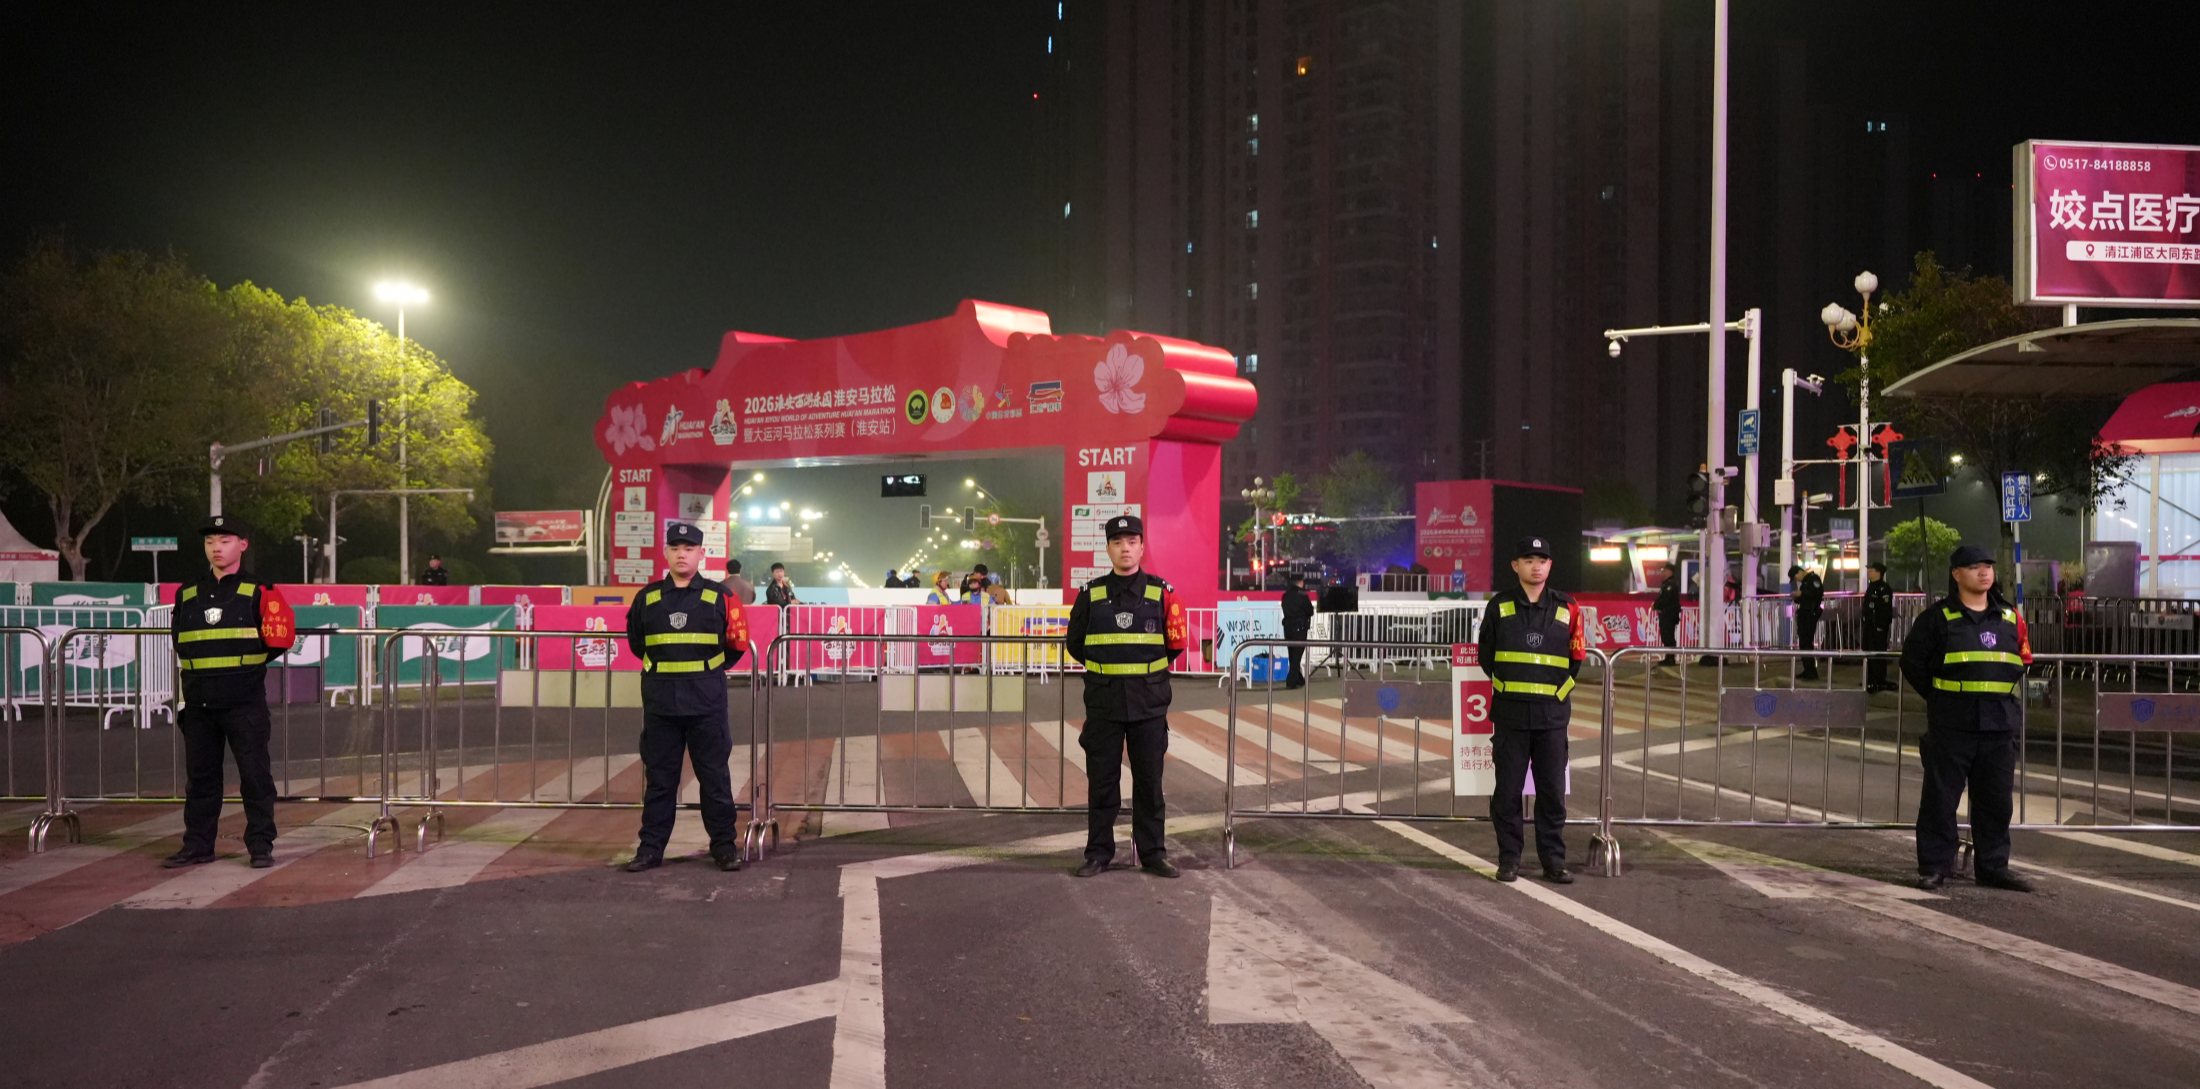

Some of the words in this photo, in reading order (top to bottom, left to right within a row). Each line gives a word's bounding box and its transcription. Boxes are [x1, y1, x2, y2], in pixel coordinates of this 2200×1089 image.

[2059, 158, 2151, 172] 0517-84188858
[2049, 188, 2200, 234] 姣点医疗
[781, 414, 800, 423] WORLD
[808, 411, 840, 421] ADVENTURE
[863, 407, 896, 417] MARATHON
[1078, 447, 1136, 467] START
[619, 469, 652, 483] START
[2005, 476, 2016, 519] 不闯红灯
[2017, 475, 2029, 519] 做文明人
[261, 624, 288, 638] 执勤
[1460, 646, 1479, 655] 此出
[1466, 694, 1488, 722] 3
[1460, 759, 1495, 771] 通行权
